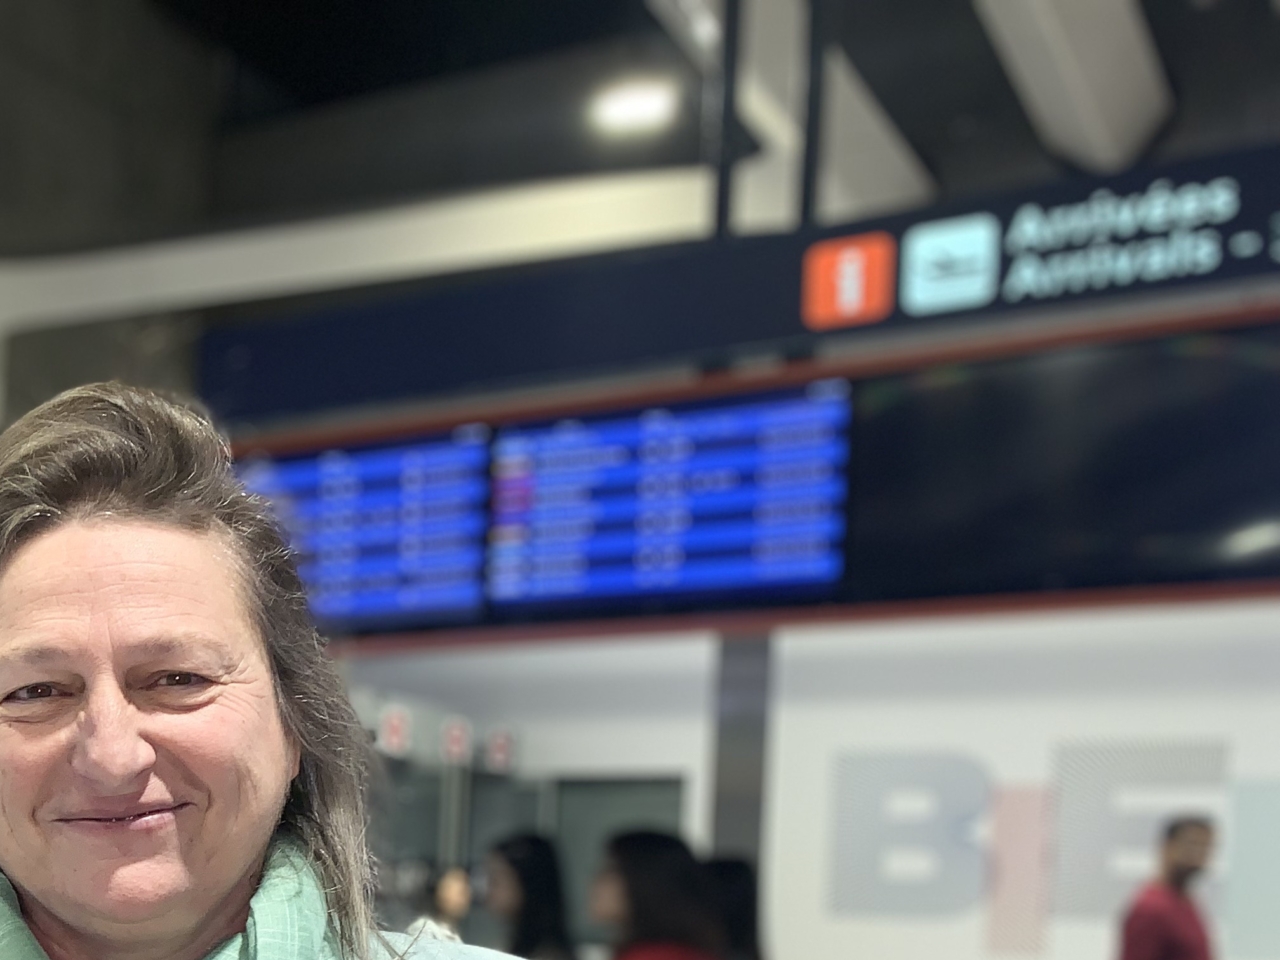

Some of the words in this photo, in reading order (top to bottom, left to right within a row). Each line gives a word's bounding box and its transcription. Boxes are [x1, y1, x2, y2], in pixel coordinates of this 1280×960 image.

[1005, 178, 1239, 255] Arrivées
[1002, 228, 1222, 301] Arrivals
[826, 740, 1280, 958] BIE
